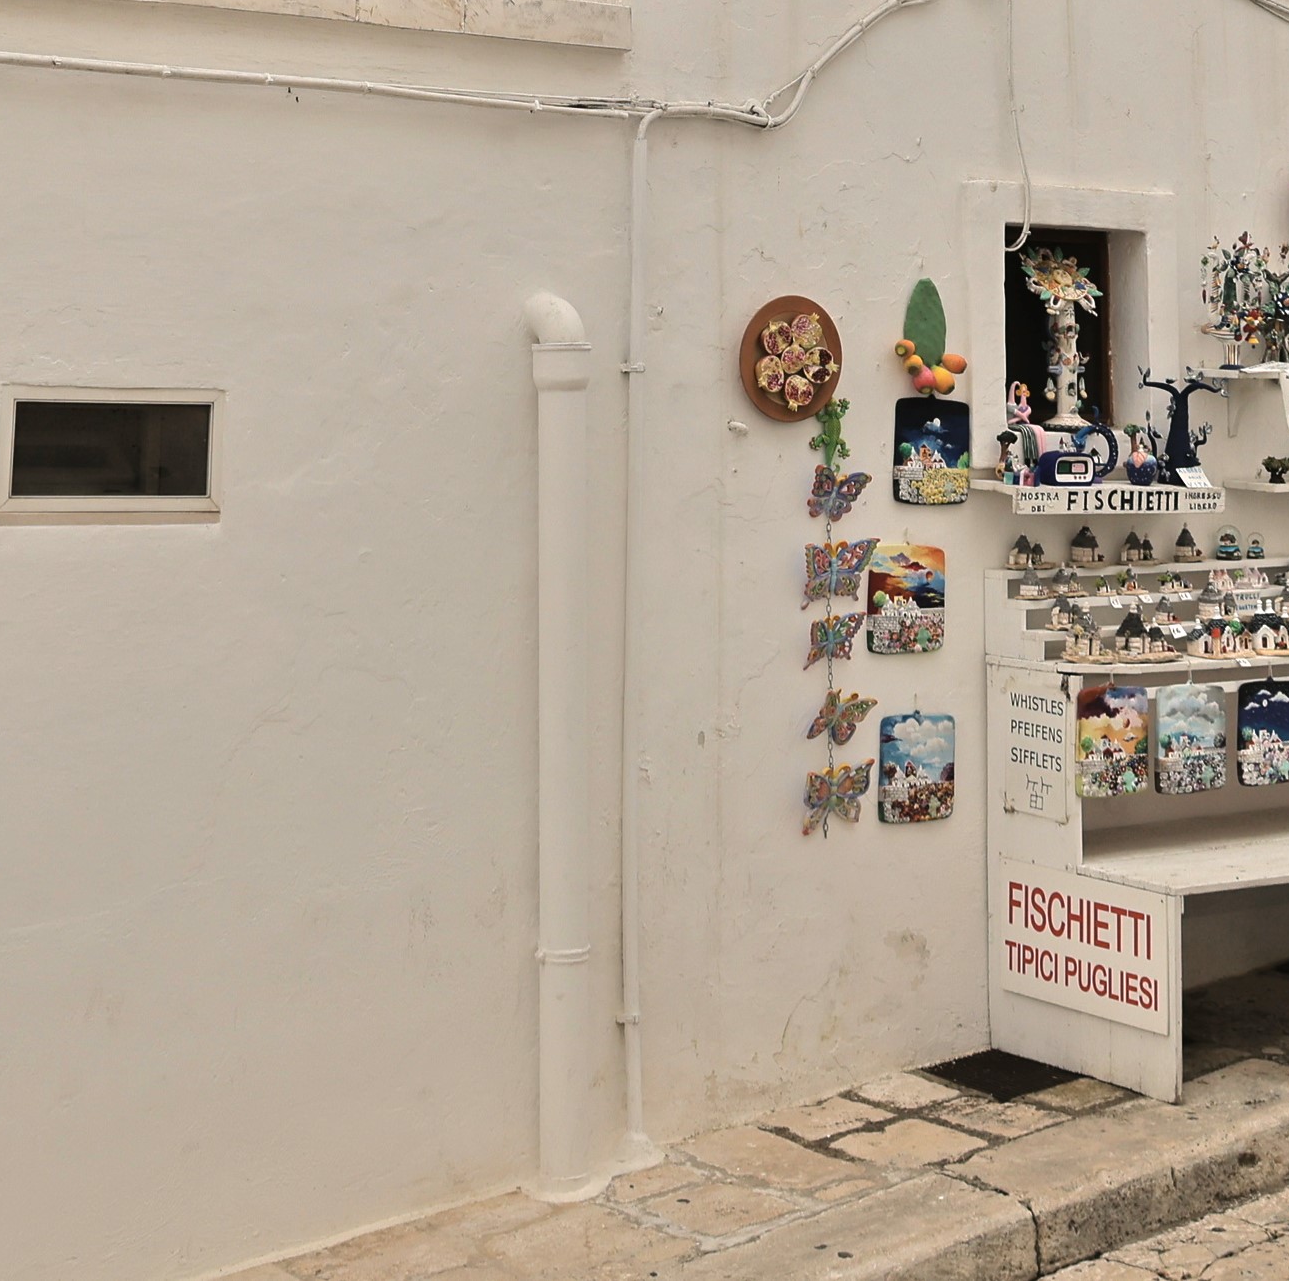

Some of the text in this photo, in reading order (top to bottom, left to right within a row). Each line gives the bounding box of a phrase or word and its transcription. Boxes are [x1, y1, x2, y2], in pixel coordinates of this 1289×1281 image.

[1021, 491, 1060, 501] MOSTRA
[1067, 490, 1179, 511] FISCHIETTI
[1010, 692, 1064, 717] WHISTLES
[1011, 719, 1063, 744] PFEIFENS
[1011, 747, 1062, 772] SIFFLETS
[1009, 881, 1151, 960] FISCHIETTI
[1005, 939, 1158, 1011] TIPICI PUGLIESI
